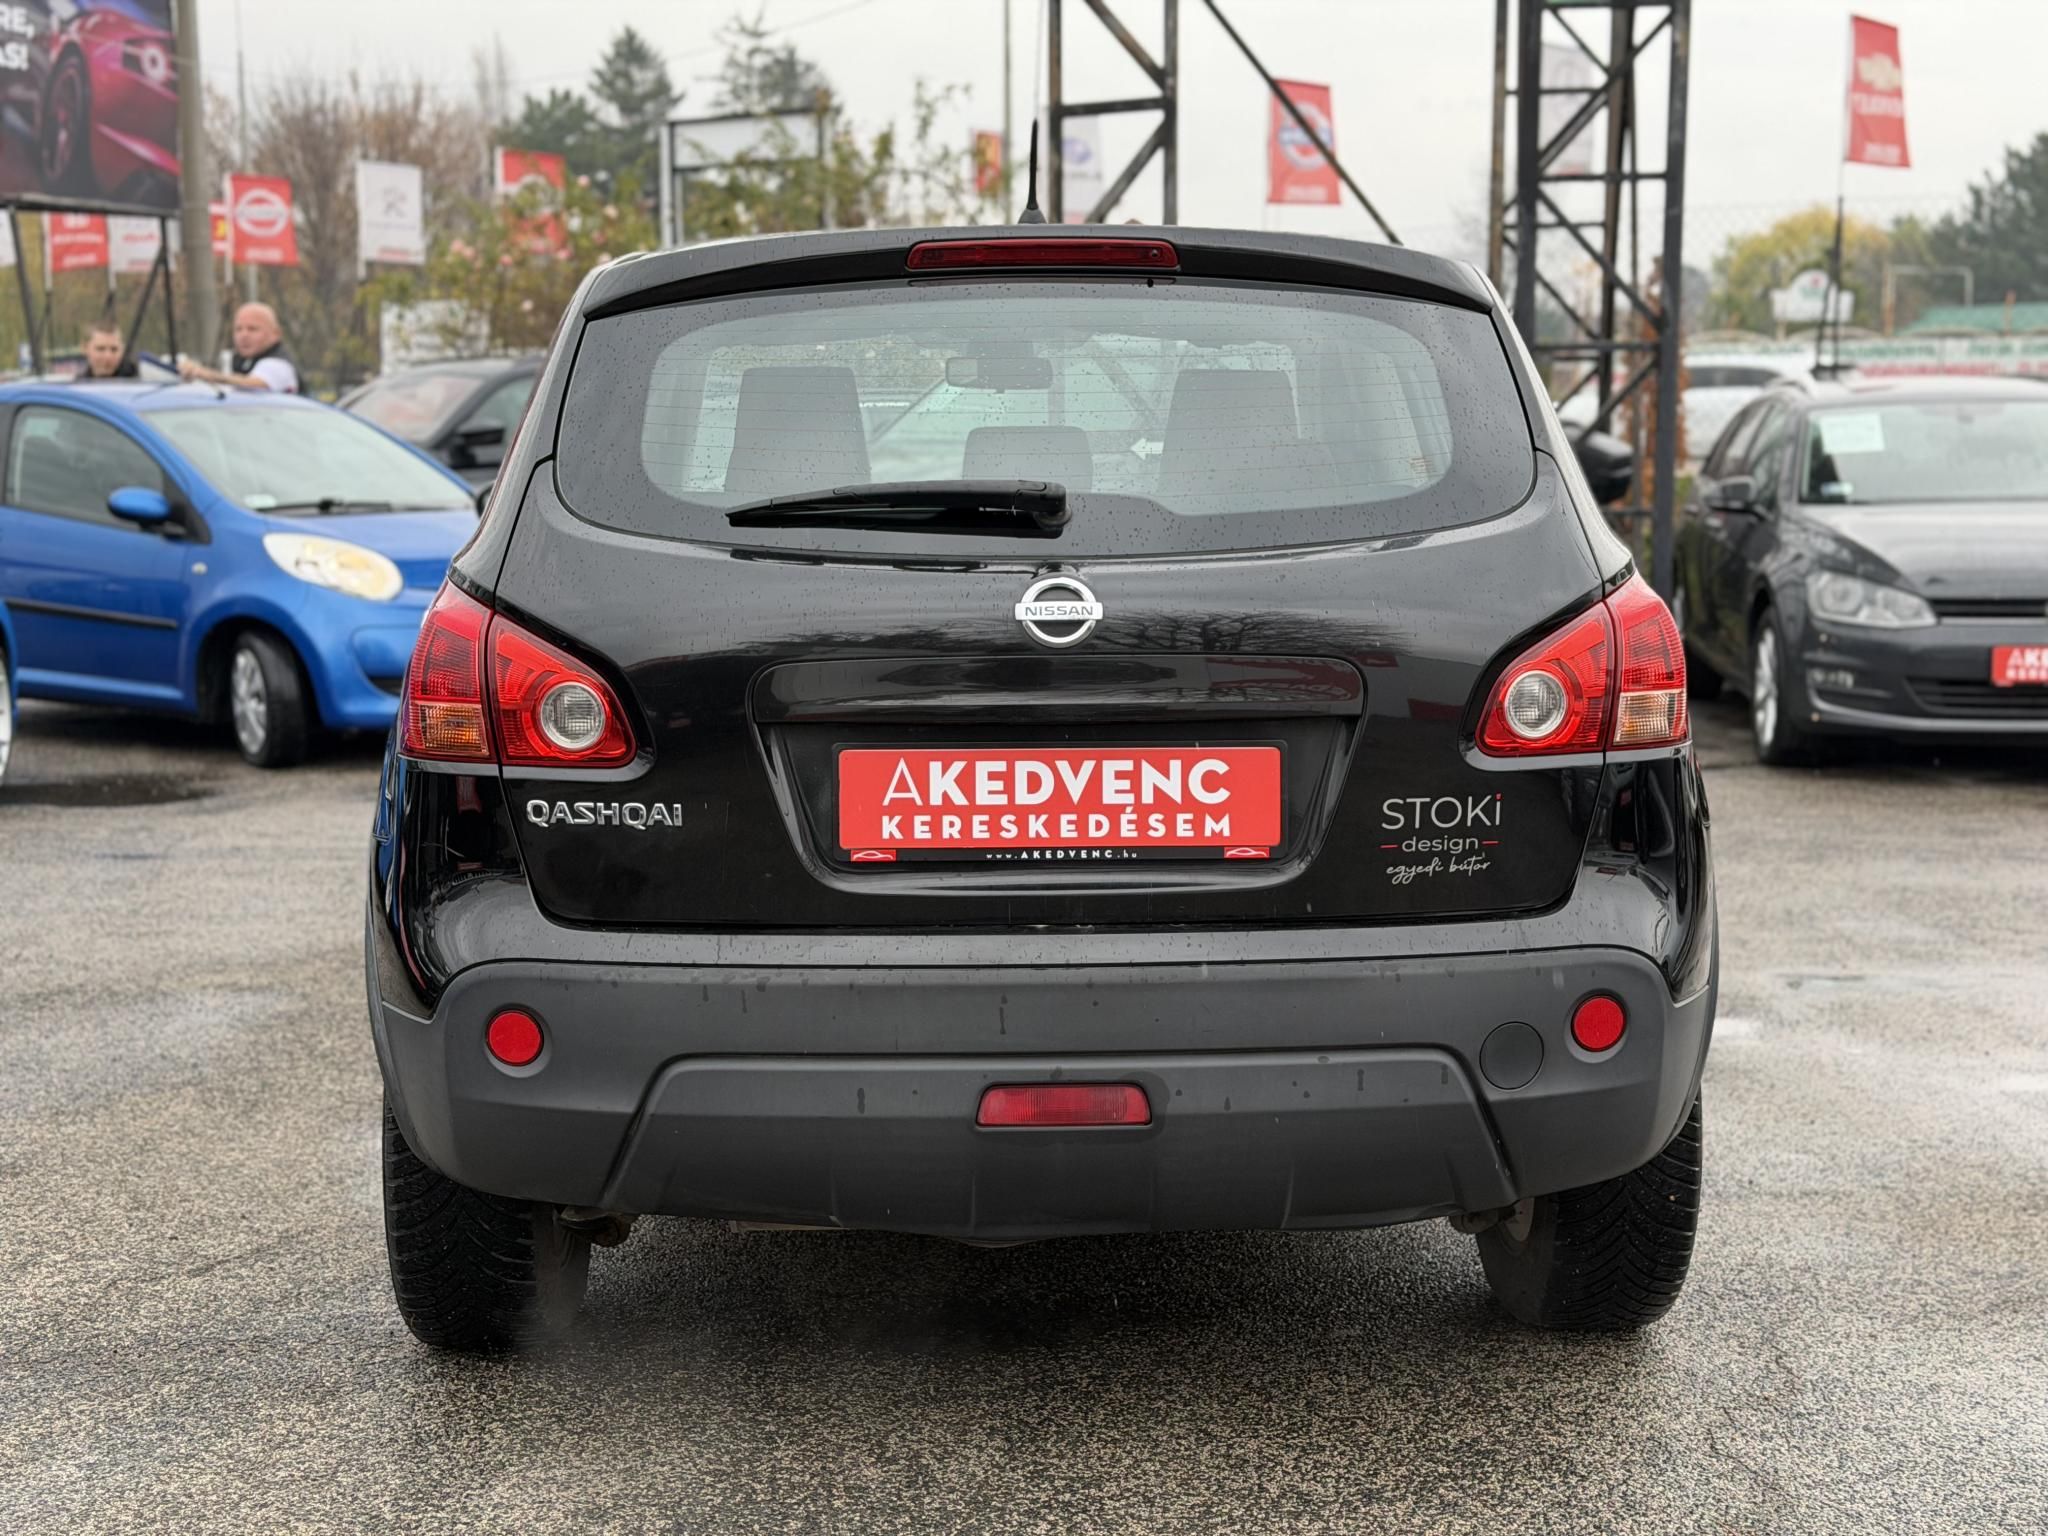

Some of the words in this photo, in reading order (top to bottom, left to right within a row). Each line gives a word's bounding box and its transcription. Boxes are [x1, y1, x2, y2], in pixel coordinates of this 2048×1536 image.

[1025, 606, 1093, 616] NISSAN
[882, 757, 1231, 806] AKEDVENC
[526, 799, 683, 830] QASHQAI
[881, 806, 1231, 840] KERESKEDÉSEM
[986, 849, 1138, 859] www.AKEDVENC.hu
[1401, 835, 1479, 854] design
[1386, 857, 1444, 885] egyedi
